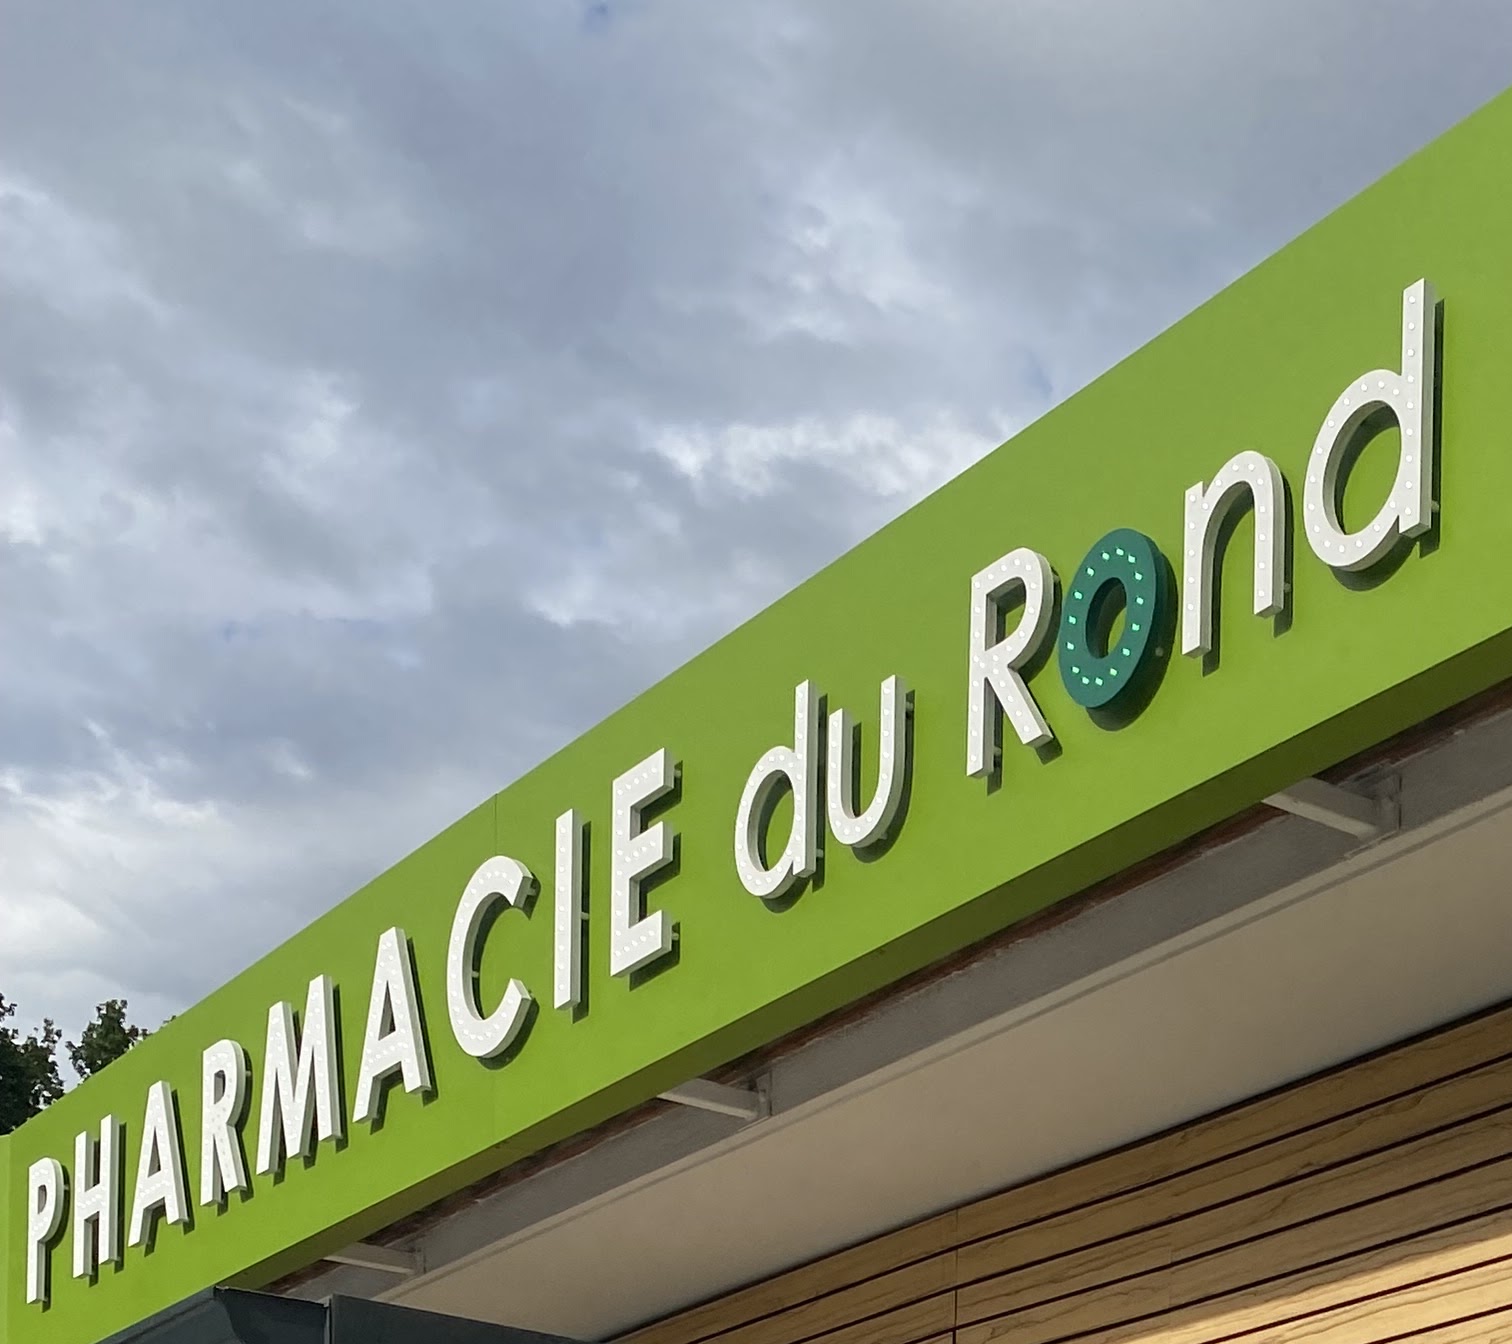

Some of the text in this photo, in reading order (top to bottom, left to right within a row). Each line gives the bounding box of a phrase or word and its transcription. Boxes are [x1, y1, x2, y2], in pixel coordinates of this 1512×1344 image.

[27, 748, 678, 1305] PHARMACIE
[735, 674, 908, 899] du
[967, 279, 1436, 779] Rond
